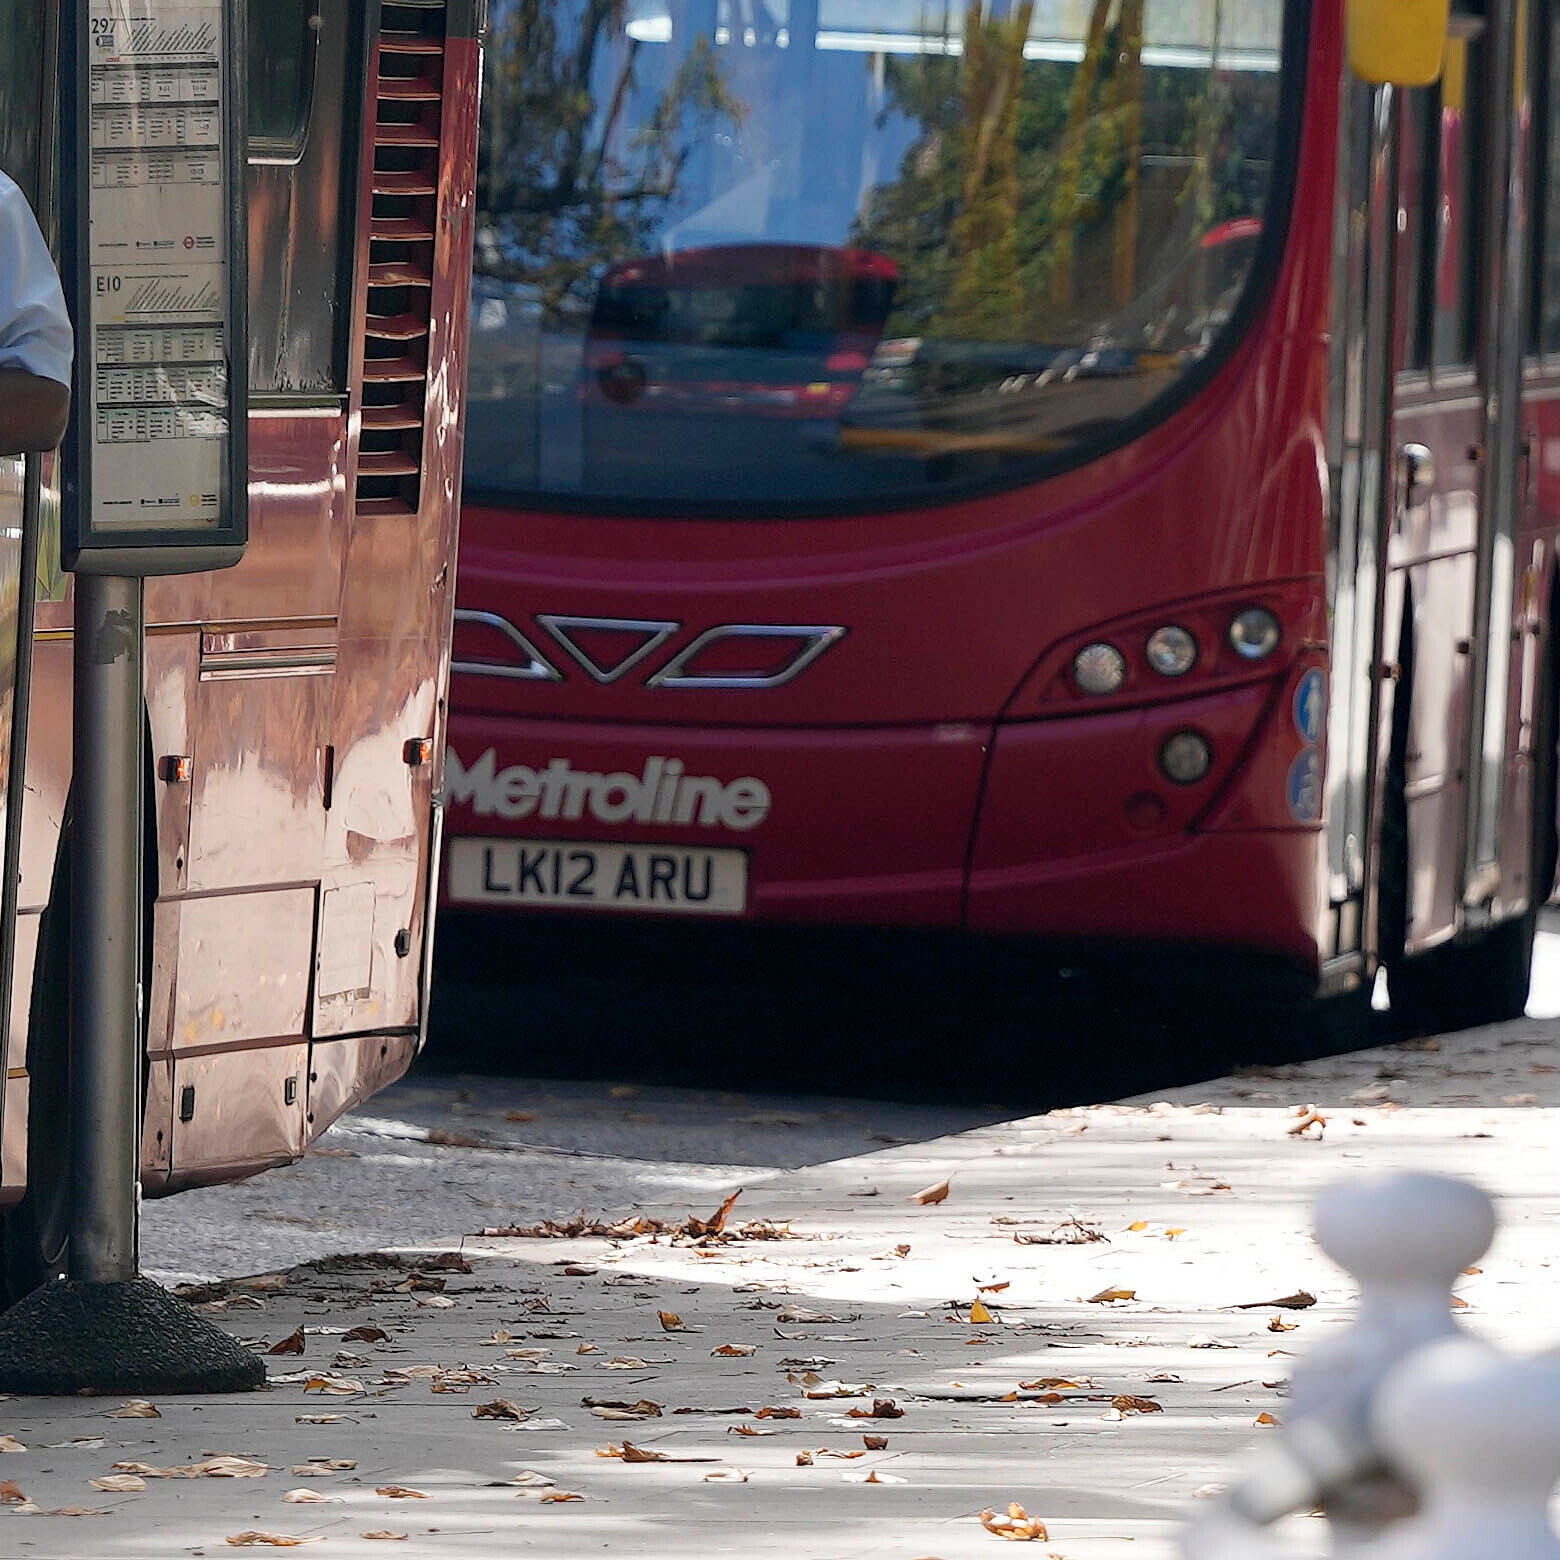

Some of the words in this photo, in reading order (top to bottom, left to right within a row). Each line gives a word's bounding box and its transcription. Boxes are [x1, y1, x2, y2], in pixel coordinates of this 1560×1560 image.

[90, 18, 117, 35] 297
[96, 275, 122, 293] E10
[445, 745, 772, 832] Metroline
[483, 846, 597, 897] LK12
[615, 852, 714, 902] ARU
